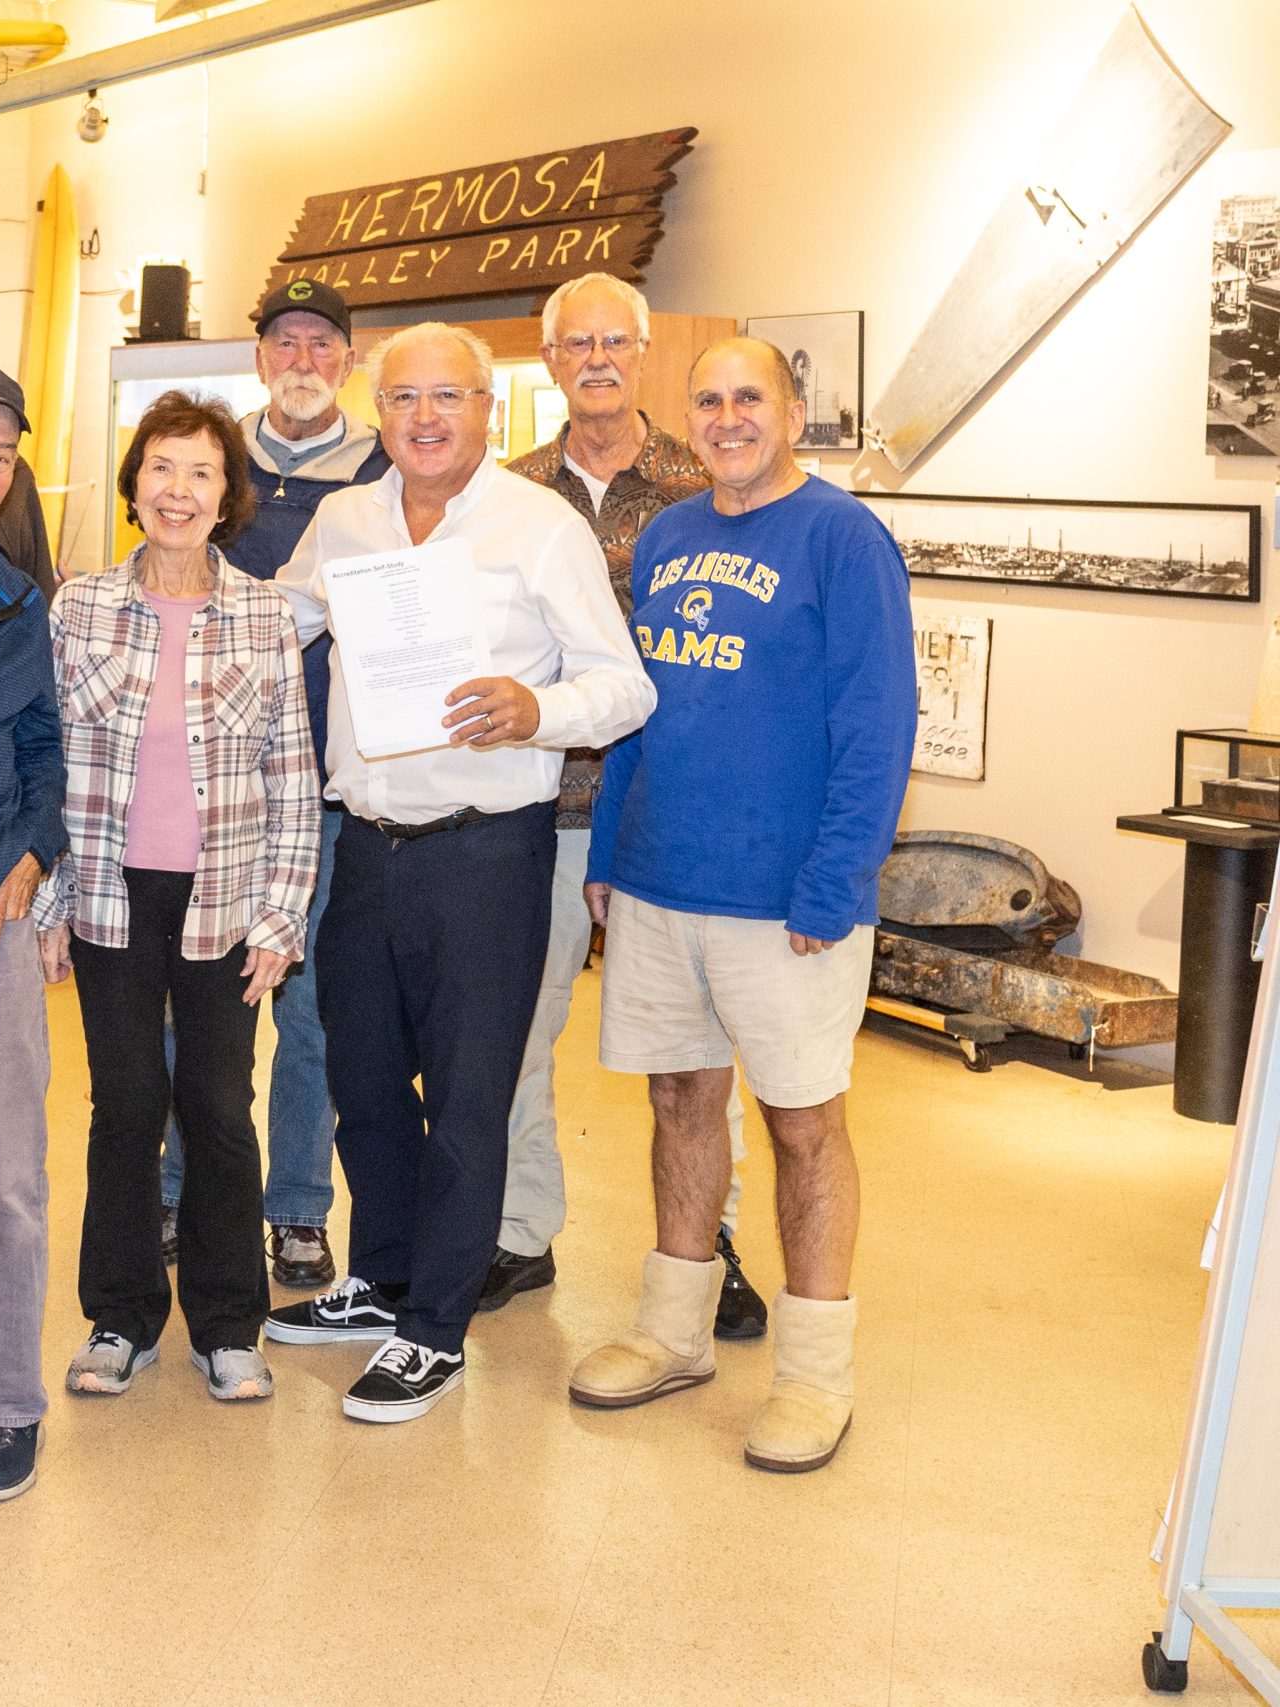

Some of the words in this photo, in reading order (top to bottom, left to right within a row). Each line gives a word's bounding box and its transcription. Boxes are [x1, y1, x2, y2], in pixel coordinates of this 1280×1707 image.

[325, 150, 606, 246] HERMOSA
[477, 224, 621, 273] PARK
[332, 567, 372, 579] Accreditation
[373, 561, 404, 572] Self-Study
[649, 555, 689, 596] LOS
[682, 551, 780, 604] ANGELES
